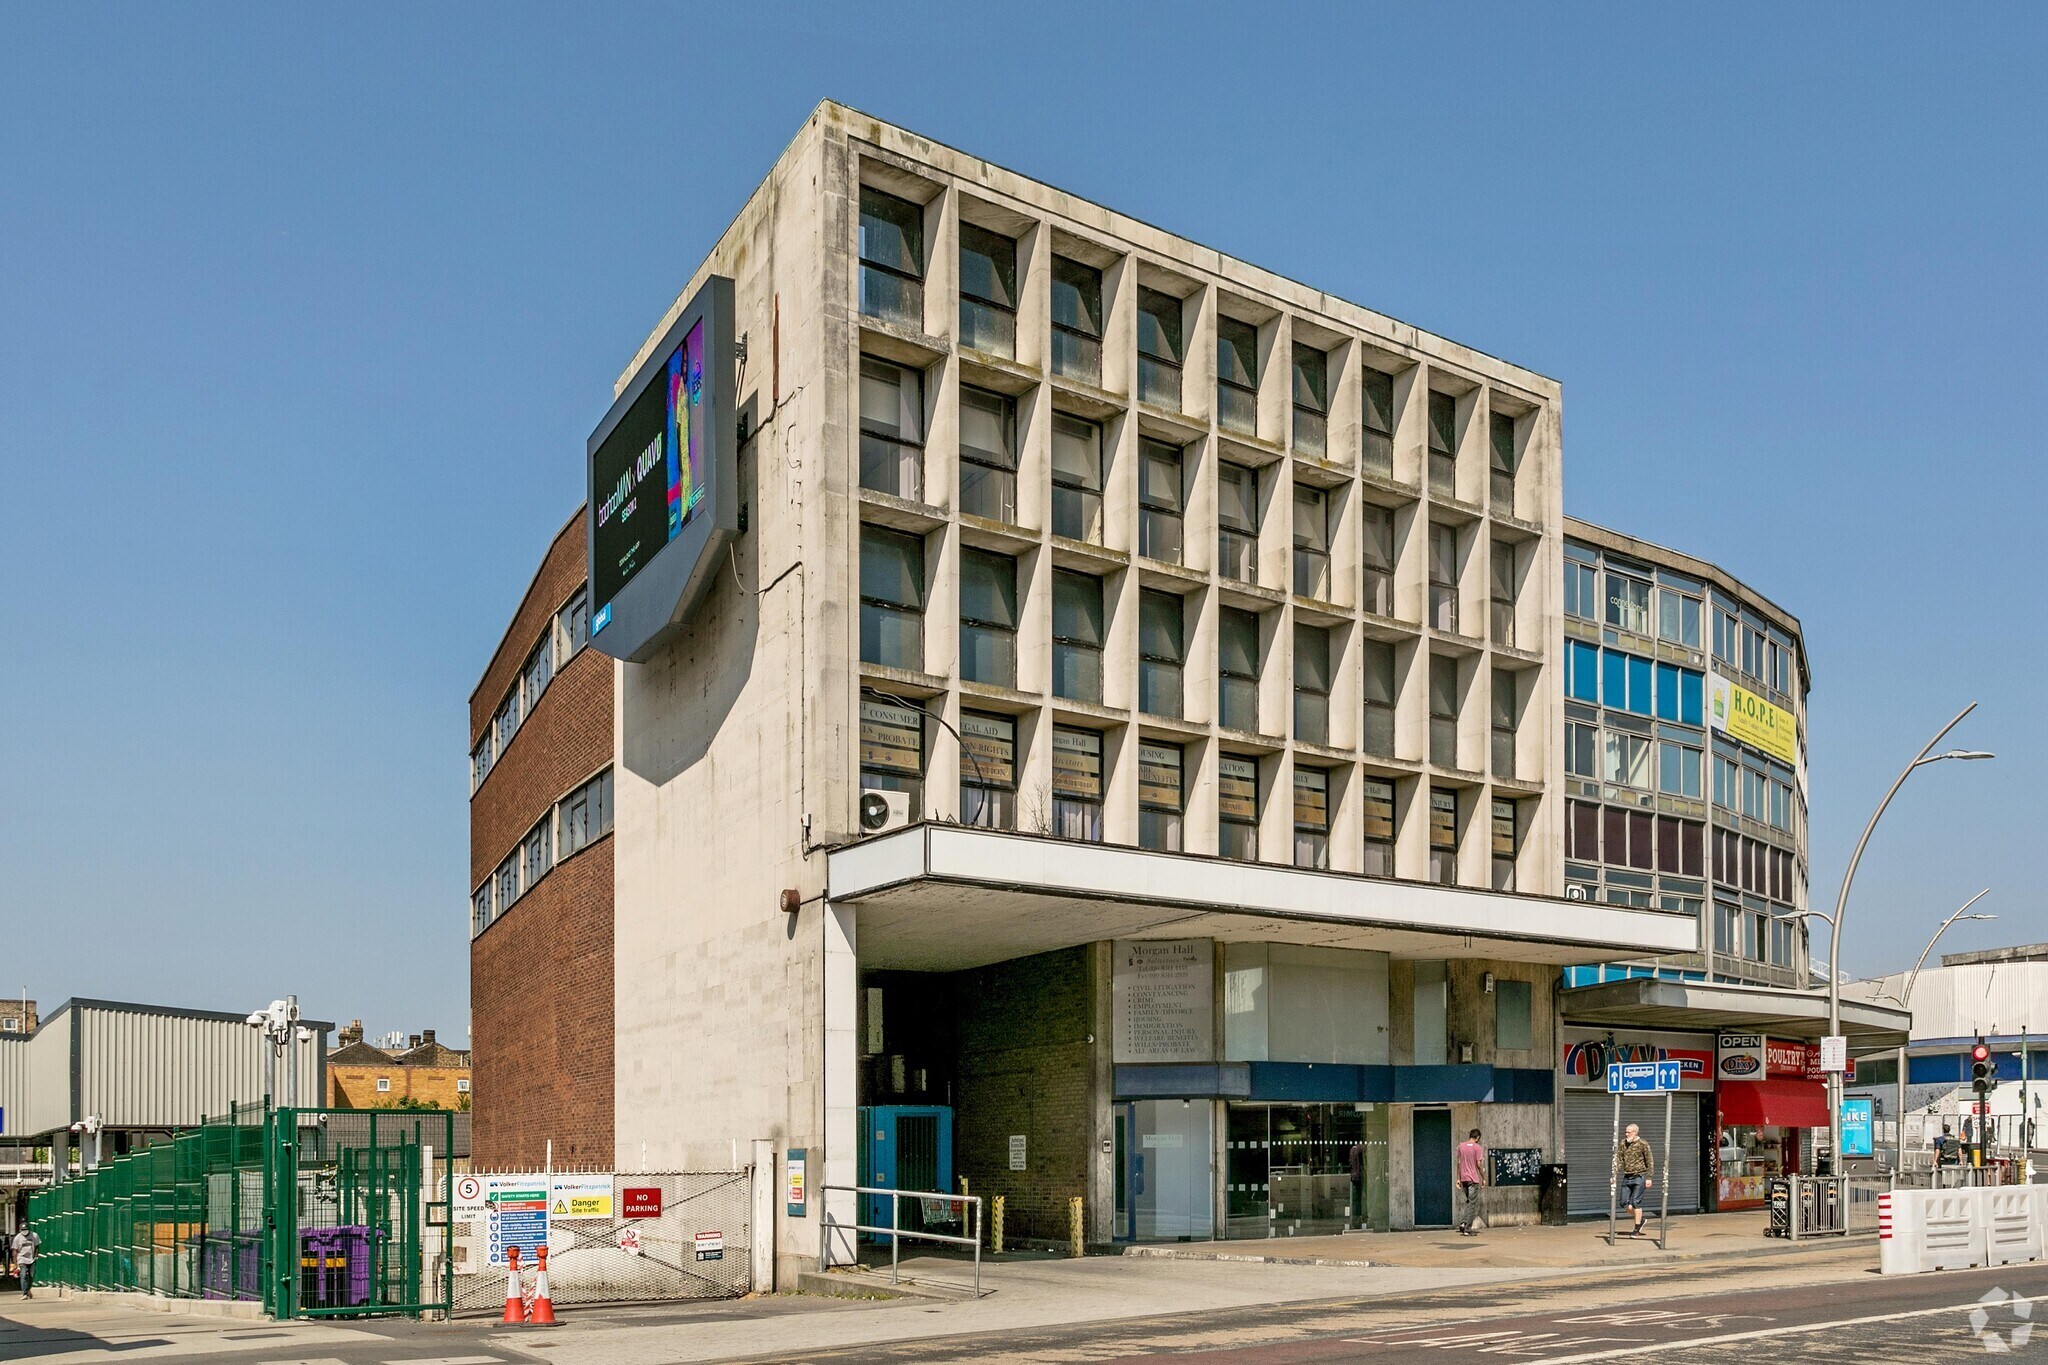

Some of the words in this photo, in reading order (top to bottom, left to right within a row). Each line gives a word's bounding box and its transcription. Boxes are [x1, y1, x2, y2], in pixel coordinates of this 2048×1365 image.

[870, 709, 918, 726] CONSUMER
[984, 726, 998, 736] AID
[878, 732, 918, 746] PROBATE
[1072, 738, 1086, 747] Hall
[978, 743, 1009, 756] RIGHTS
[1133, 946, 1168, 955] Morgan
[1173, 945, 1193, 954] Hall
[1721, 1036, 1761, 1048] OPEN
[1767, 1048, 1801, 1065] POULTRY
[465, 1184, 473, 1194] 5
[572, 1199, 600, 1207] Danger
[626, 1204, 658, 1212] PARKING
[1552, 1310, 1777, 1330] BUS
[1340, 1328, 1656, 1356] LANE
